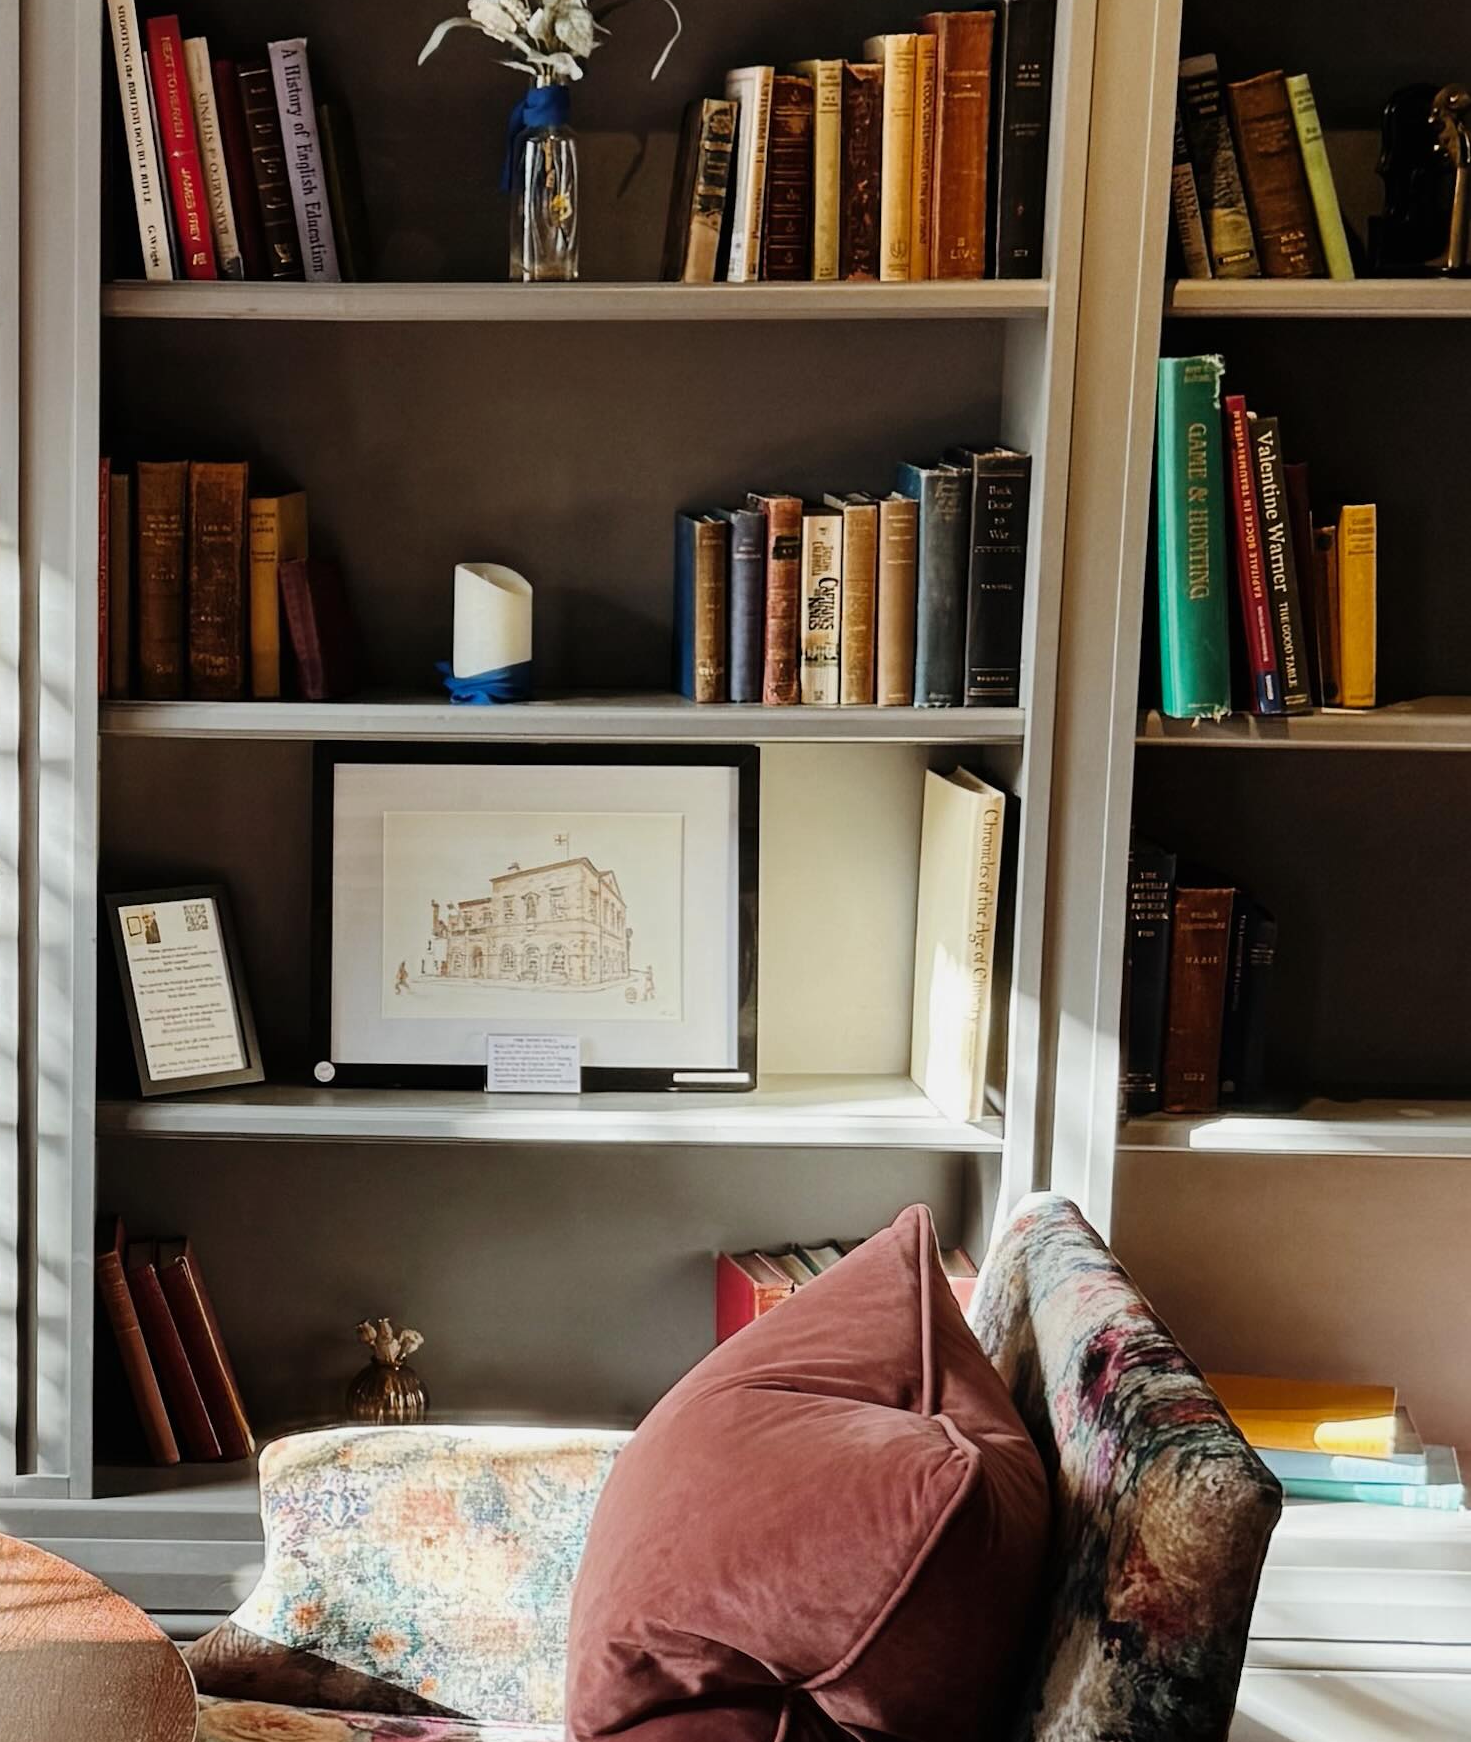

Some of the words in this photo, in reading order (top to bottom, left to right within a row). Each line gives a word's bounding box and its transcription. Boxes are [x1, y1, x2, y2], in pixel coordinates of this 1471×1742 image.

[117, 5, 133, 63] SHOOTING
[160, 36, 176, 69] NEXT
[281, 49, 297, 59] A
[165, 71, 177, 89] TO
[283, 63, 304, 117] History
[292, 120, 311, 136] of
[295, 141, 317, 196] English
[177, 167, 196, 209] JAMES
[185, 211, 201, 242] FREY
[305, 201, 325, 273] Education
[1188, 423, 1208, 478] GAME
[987, 499, 1014, 510] Door
[989, 484, 1012, 496] Back
[1188, 486, 1209, 502] &
[1256, 430, 1278, 520] Valentine
[1267, 523, 1288, 593] Warner
[988, 529, 1011, 540] War
[1188, 507, 1211, 601] HUNTING
[818, 577, 839, 630] CAPTAINS
[1281, 624, 1294, 653] GOOD
[980, 808, 998, 878] Chronicles
[977, 894, 993, 918] the
[968, 919, 990, 949] Age
